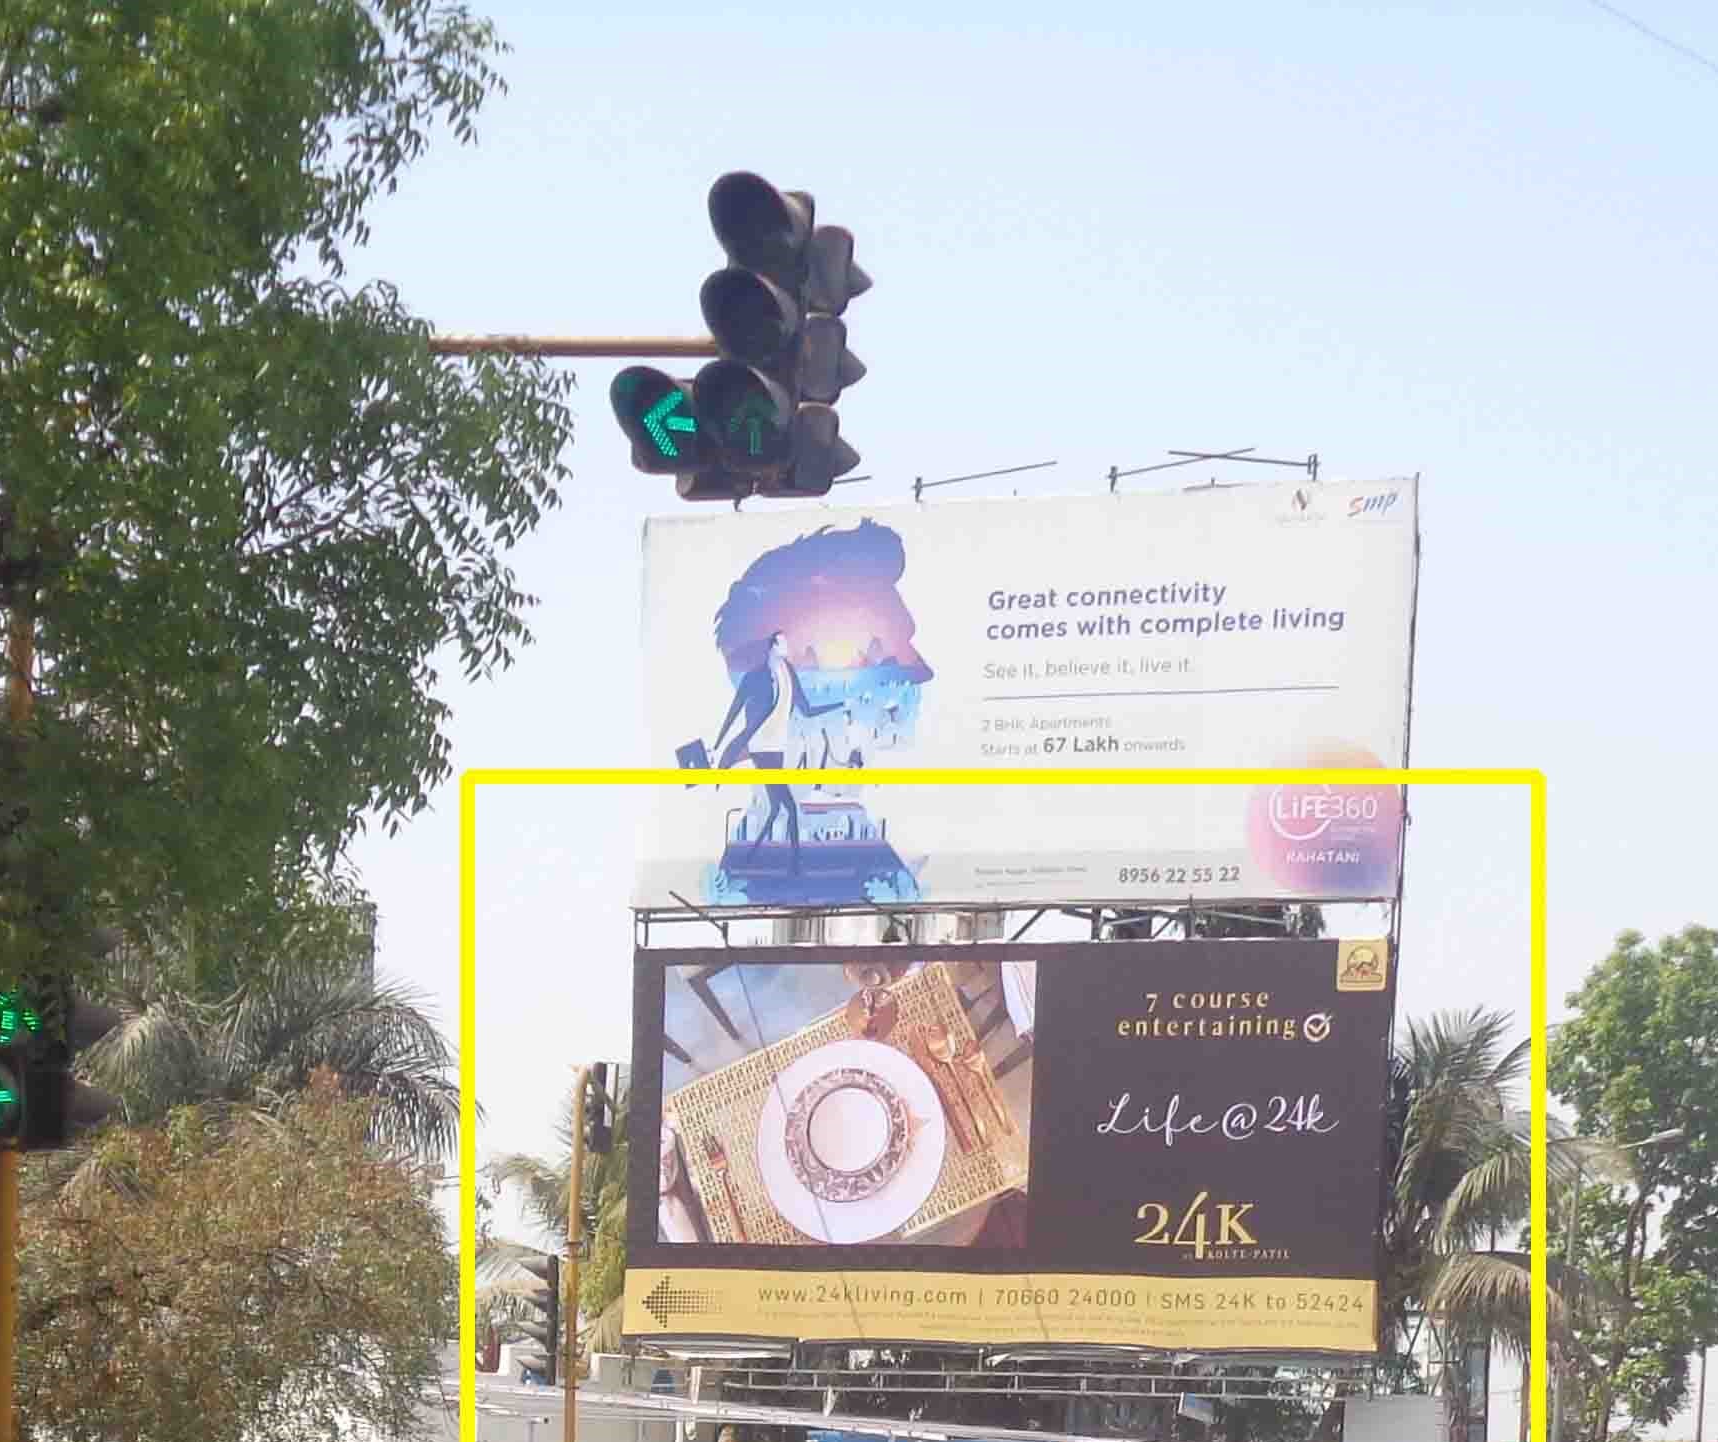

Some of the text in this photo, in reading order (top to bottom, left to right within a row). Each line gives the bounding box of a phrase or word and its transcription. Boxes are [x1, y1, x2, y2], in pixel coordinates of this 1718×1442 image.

[988, 581, 1227, 612] Great connectivity
[986, 607, 1346, 640] comes with complete living
[983, 662, 1018, 680] See
[1044, 659, 1111, 677] believe
[1140, 657, 1172, 674] live
[1042, 736, 1067, 753] 67
[1073, 735, 1119, 753] Lakh
[1118, 865, 1241, 884] 8956 22 55 22
[1146, 991, 1270, 1012] 7 course
[1117, 1015, 1297, 1041] entertaining
[1096, 1092, 1220, 1147] Life
[1263, 1092, 1341, 1134] 24k
[1133, 1191, 1259, 1260] 24K
[1207, 1248, 1291, 1261] KOLTE-PATIL
[757, 1284, 968, 1307] www.24kliving.com
[1068, 1288, 1137, 1307] 24000
[1161, 1293, 1207, 1311] SMS
[1215, 1292, 1256, 1311] 24K
[1266, 1294, 1287, 1311] to
[1296, 1292, 1364, 1313] 52424
